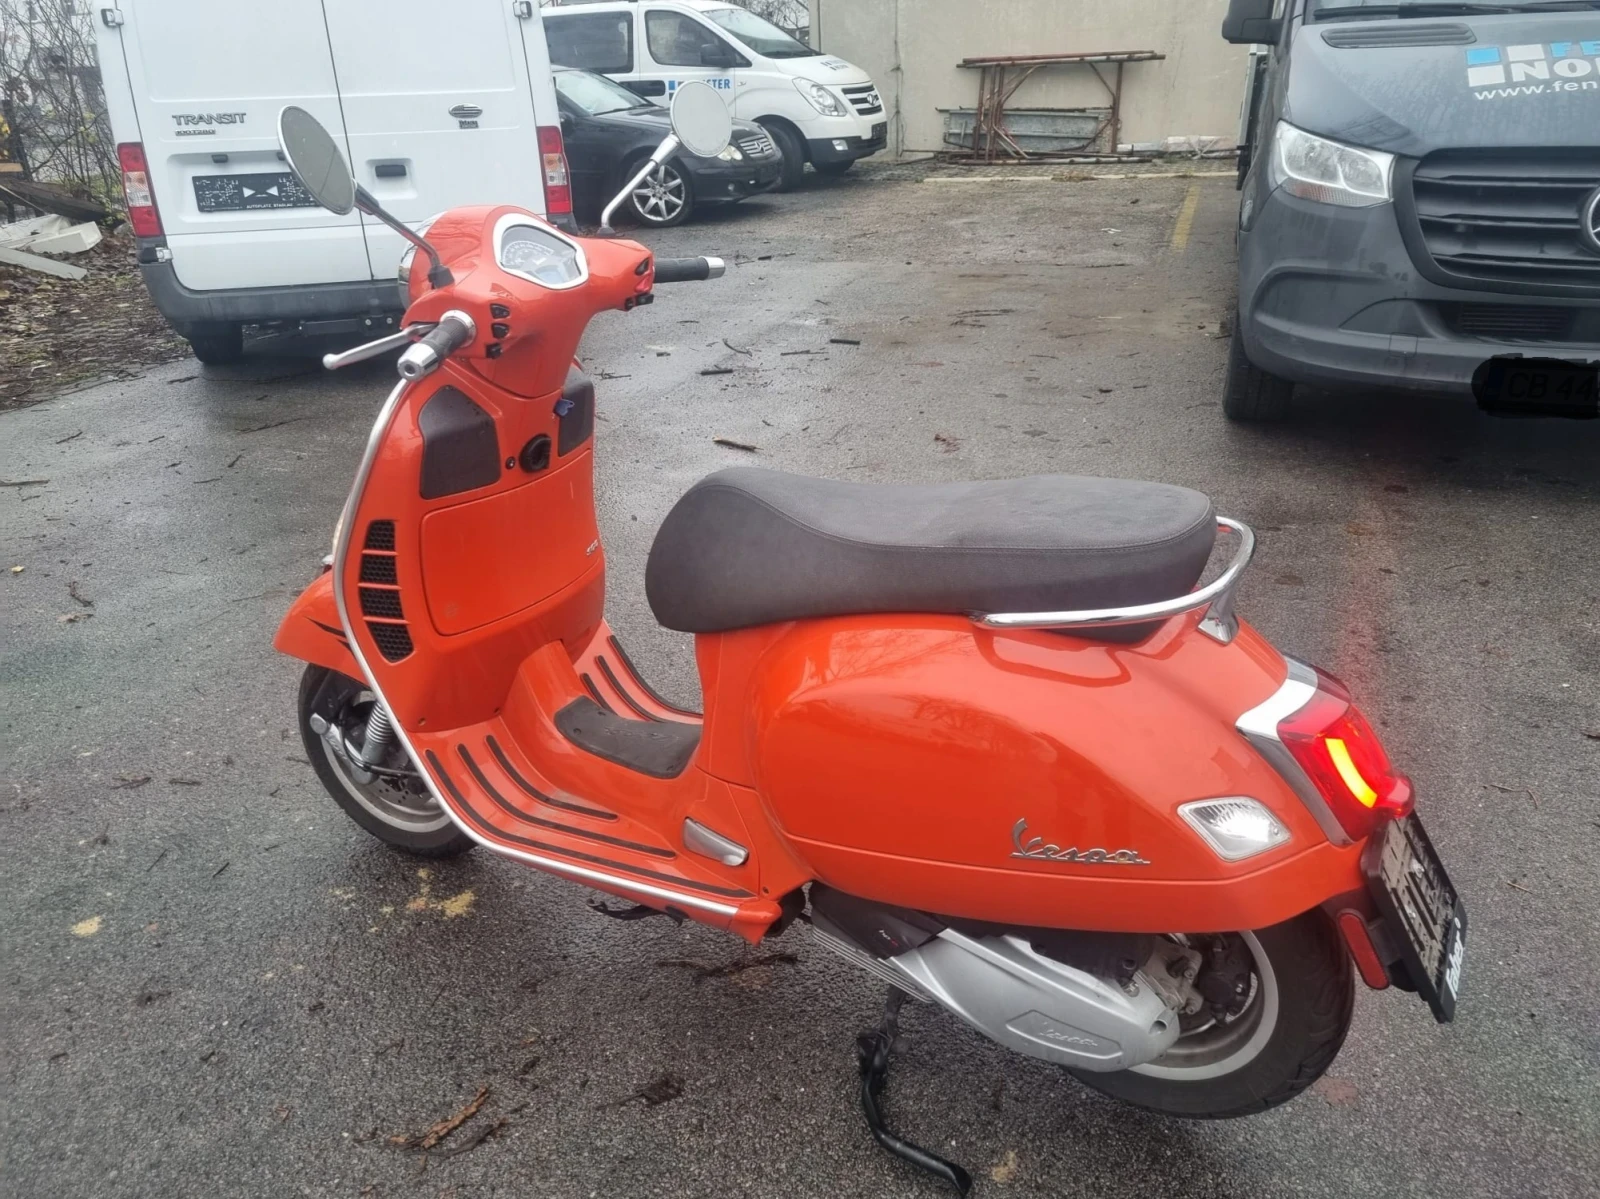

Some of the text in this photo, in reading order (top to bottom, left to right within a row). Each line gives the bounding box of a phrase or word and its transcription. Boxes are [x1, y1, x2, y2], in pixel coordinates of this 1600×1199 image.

[1510, 57, 1600, 82] NO
[171, 112, 247, 126] TRANSIT
[1009, 817, 1151, 865] Vespa
[1445, 930, 1464, 1002] Faber
